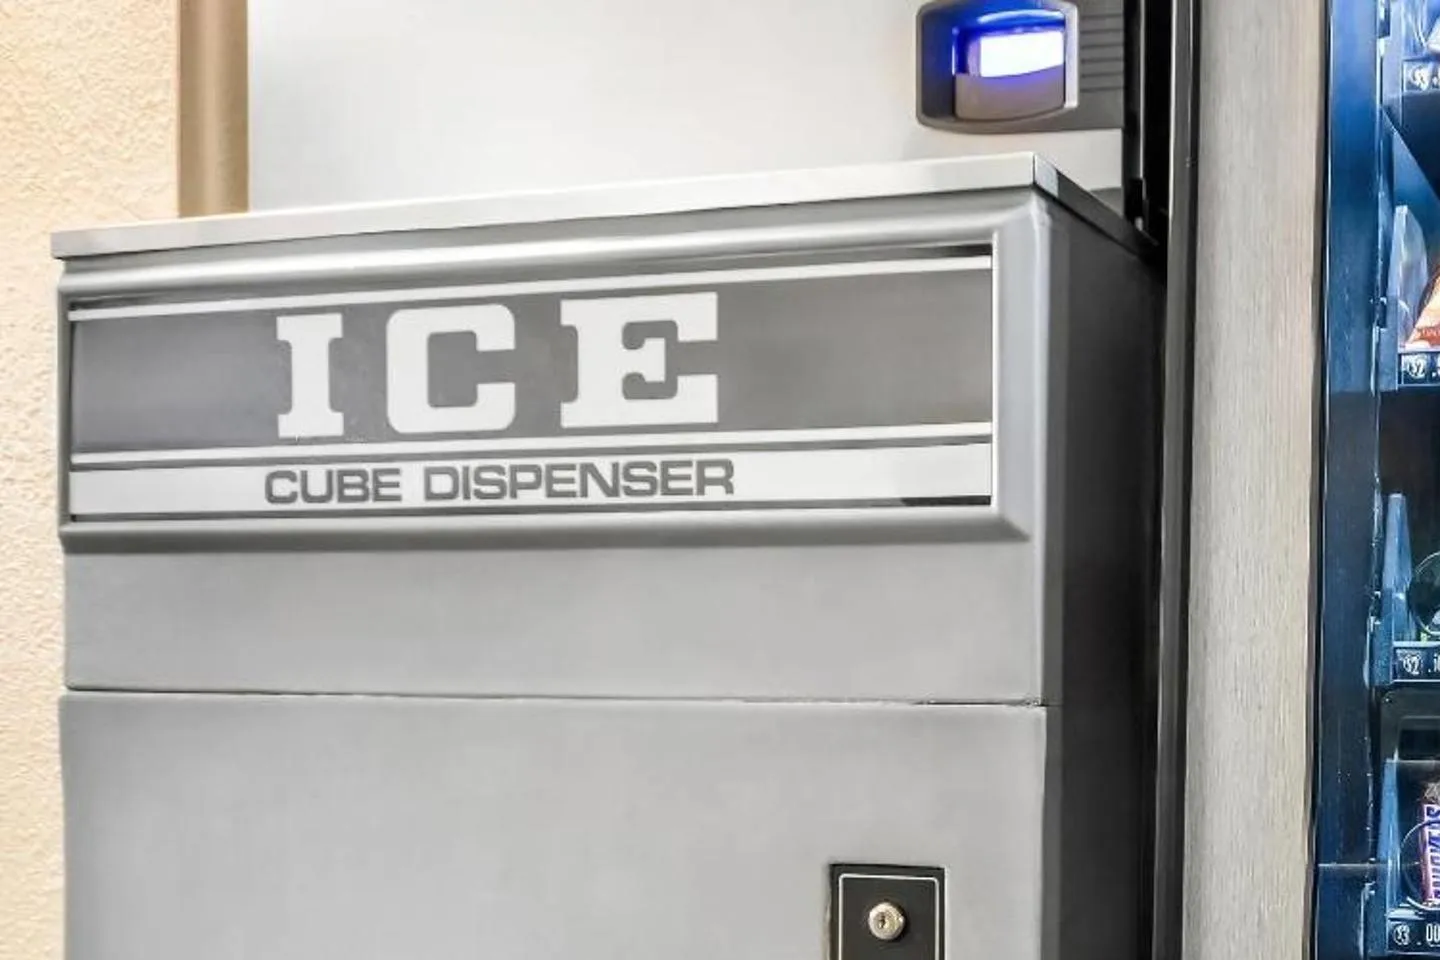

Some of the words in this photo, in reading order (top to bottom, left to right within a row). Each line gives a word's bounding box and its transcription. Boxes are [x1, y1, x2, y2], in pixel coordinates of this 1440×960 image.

[276, 291, 718, 441] ICE
[264, 465, 402, 506] CUBE
[423, 457, 735, 501] DISPENSER
